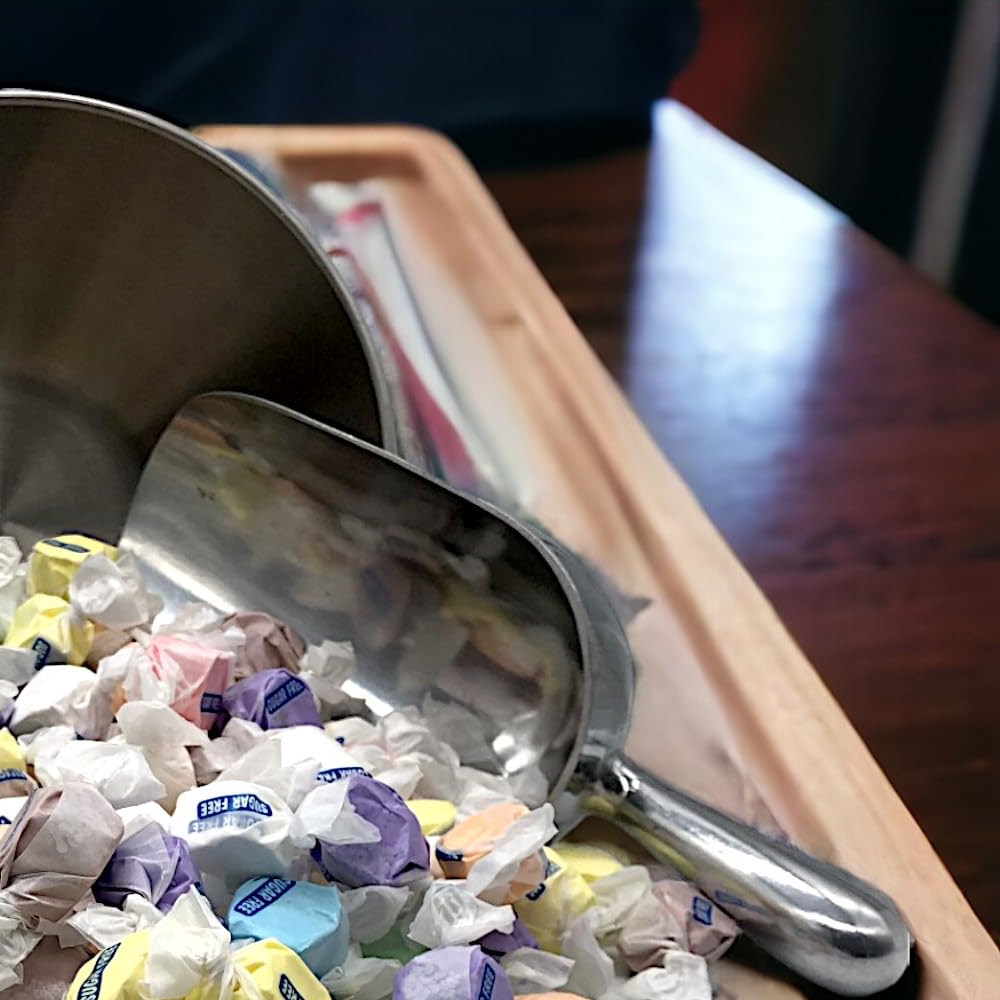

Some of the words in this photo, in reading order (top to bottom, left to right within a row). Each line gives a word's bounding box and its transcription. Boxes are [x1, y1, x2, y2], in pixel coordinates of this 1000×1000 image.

[200, 797, 229, 817] FREE
[231, 794, 270, 815] SUGAR
[237, 895, 266, 915] FREE
